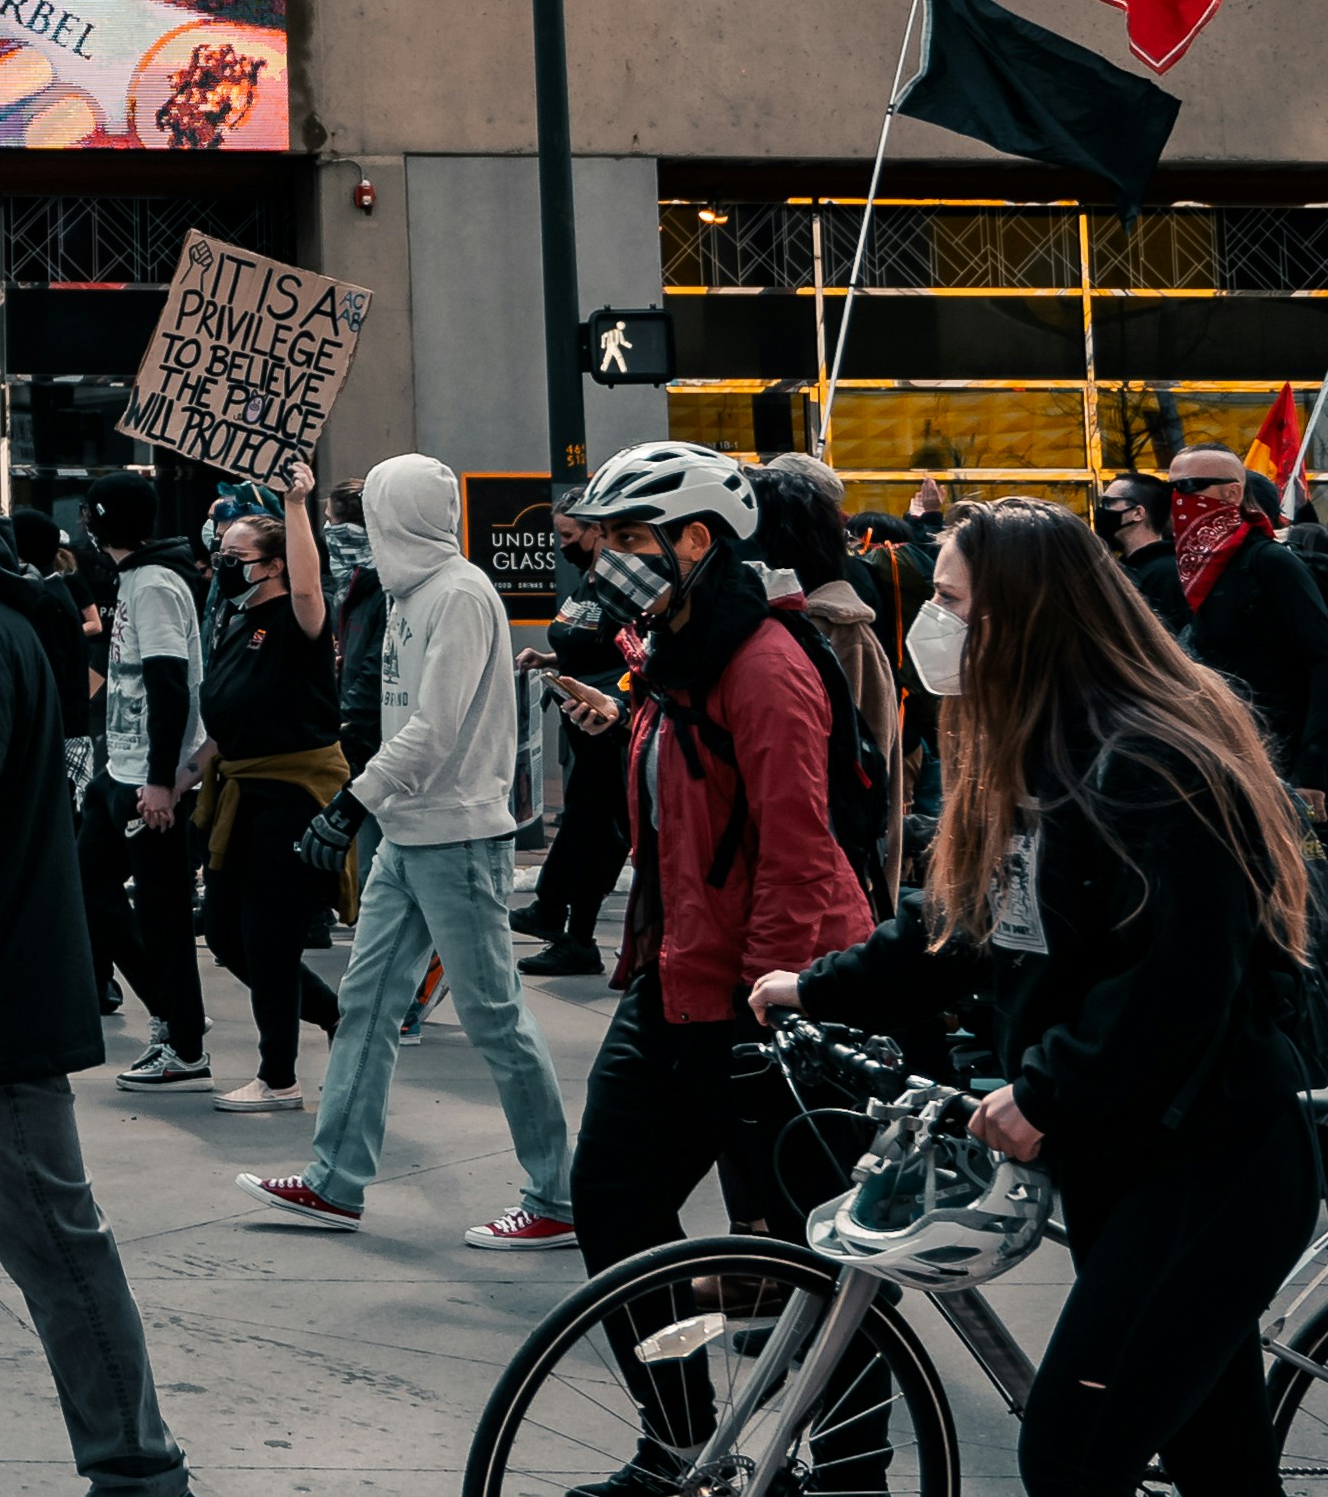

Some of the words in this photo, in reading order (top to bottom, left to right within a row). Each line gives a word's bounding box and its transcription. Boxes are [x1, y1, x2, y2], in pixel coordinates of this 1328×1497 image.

[175, 288, 343, 376] PRIVILEGE
[211, 252, 256, 305] IT
[256, 267, 302, 321] IS
[299, 285, 340, 337] A
[159, 364, 218, 409] THE
[162, 332, 202, 370] TO
[204, 344, 326, 410] BELIEVE
[123, 385, 176, 446] WILL
[176, 405, 300, 483] PROTECT
[492, 551, 556, 570] GLASS
